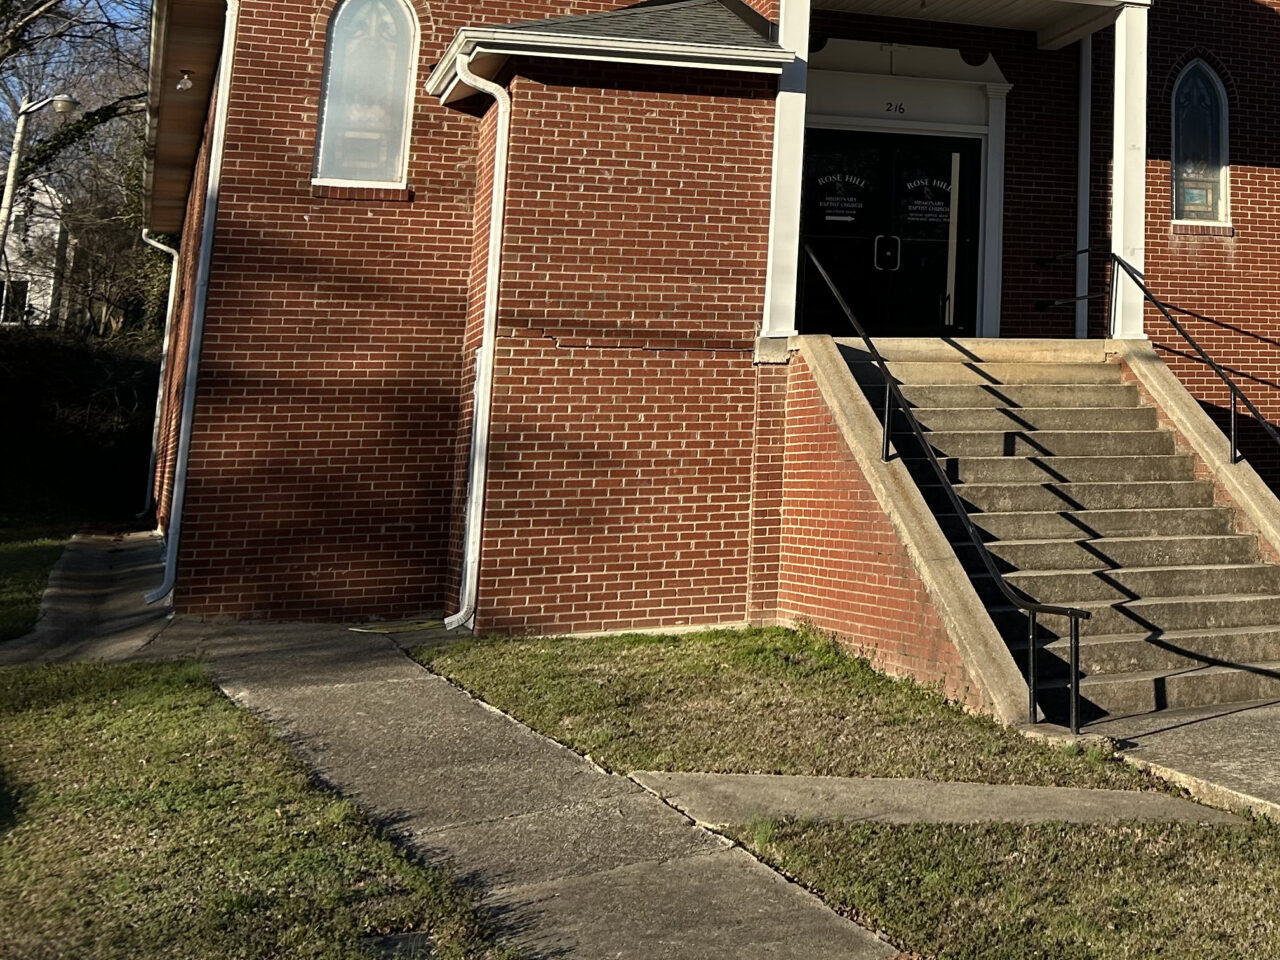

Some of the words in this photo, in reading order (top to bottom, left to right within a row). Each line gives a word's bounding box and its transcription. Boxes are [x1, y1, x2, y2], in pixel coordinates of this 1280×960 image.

[885, 102, 905, 114] 216
[817, 173, 843, 185] ROSE
[844, 174, 865, 189] HILL
[906, 178, 929, 190] ROSE
